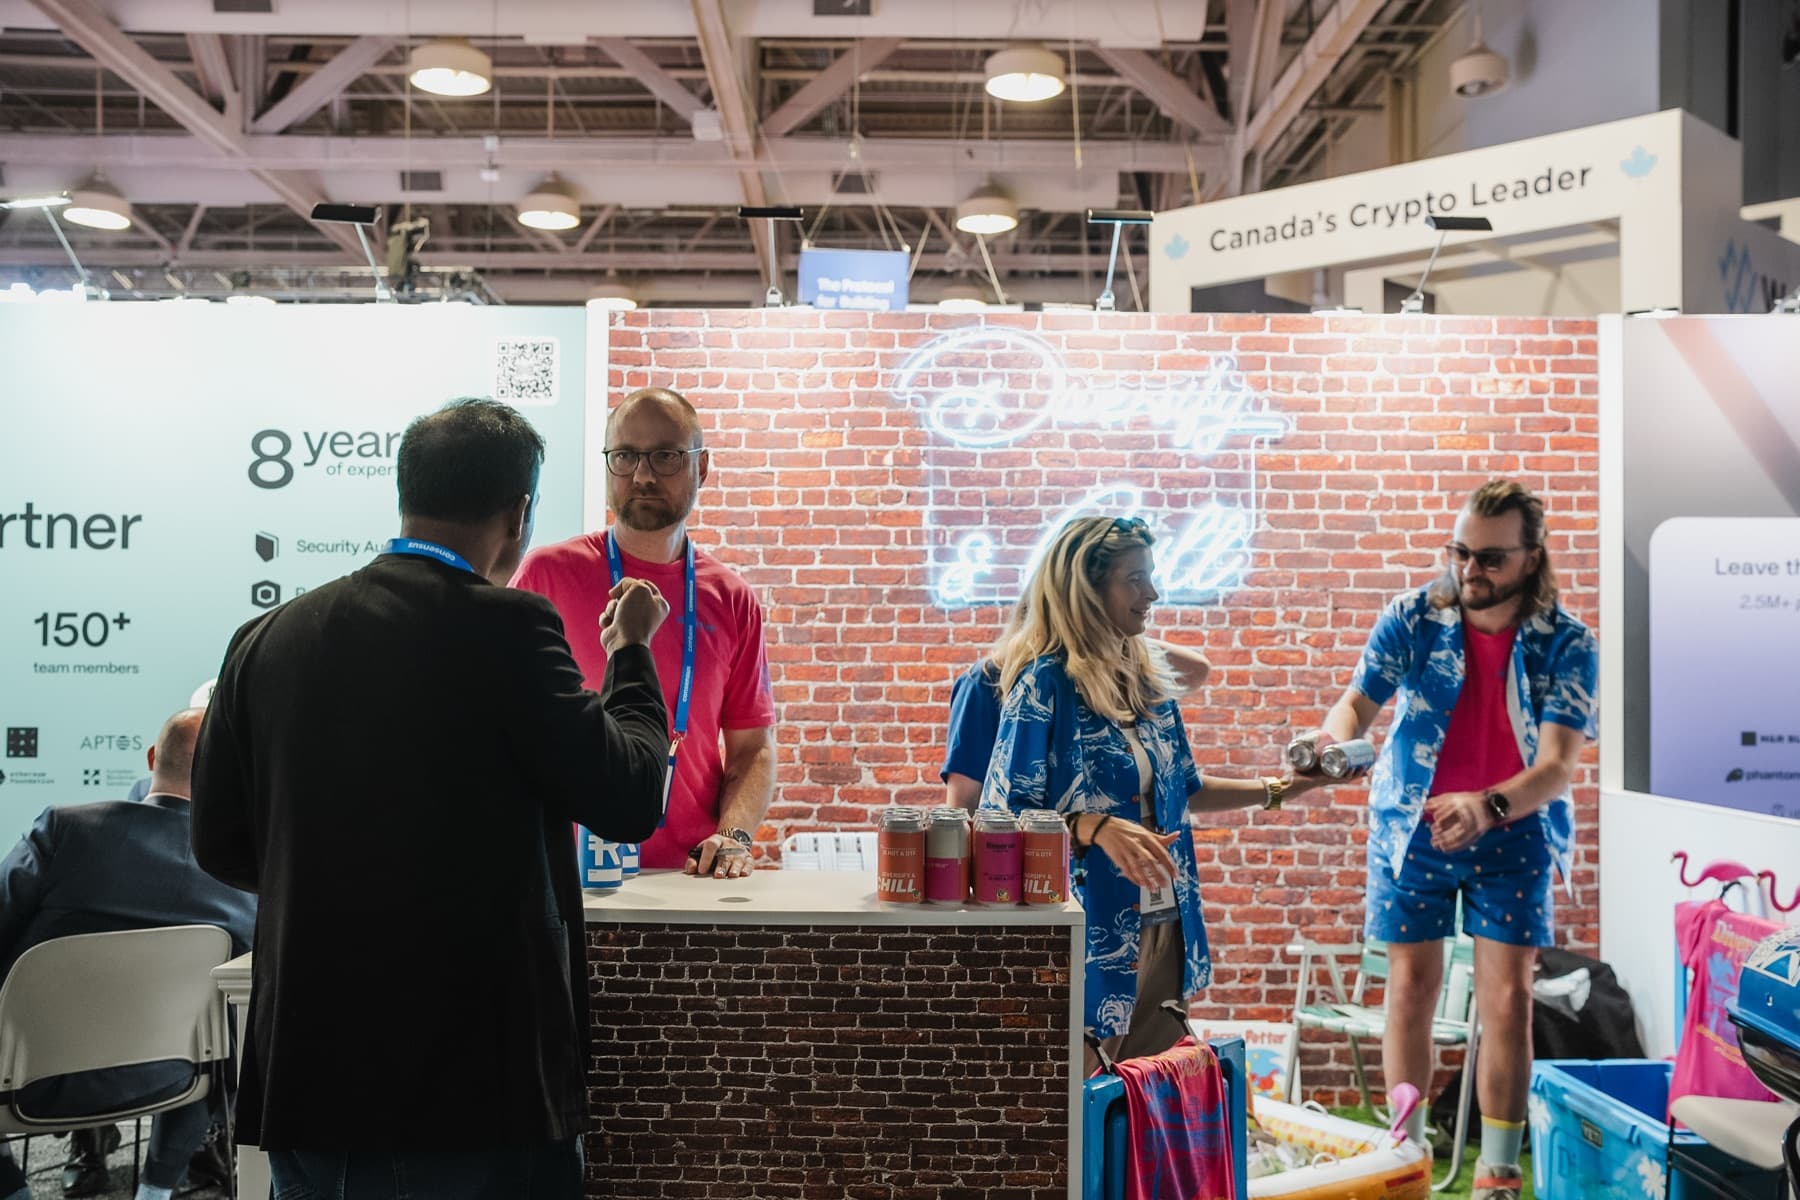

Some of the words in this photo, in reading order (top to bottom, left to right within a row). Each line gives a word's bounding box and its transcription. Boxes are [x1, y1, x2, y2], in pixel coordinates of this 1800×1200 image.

[1209, 209, 1337, 253] Canada's
[1349, 188, 1457, 230] Crypto
[1471, 165, 1593, 207] Leader
[248, 429, 295, 490] 8
[303, 430, 401, 467] year
[326, 462, 345, 476] of
[347, 464, 398, 479] exper
[0, 502, 143, 550] rtner
[296, 539, 361, 556] Security
[363, 540, 386, 553] Au
[407, 541, 457, 562] consensus
[1714, 557, 1780, 576] Leave
[33, 611, 131, 648] 150+
[33, 660, 70, 674] team
[73, 660, 140, 674] members
[80, 735, 143, 751] APTOS
